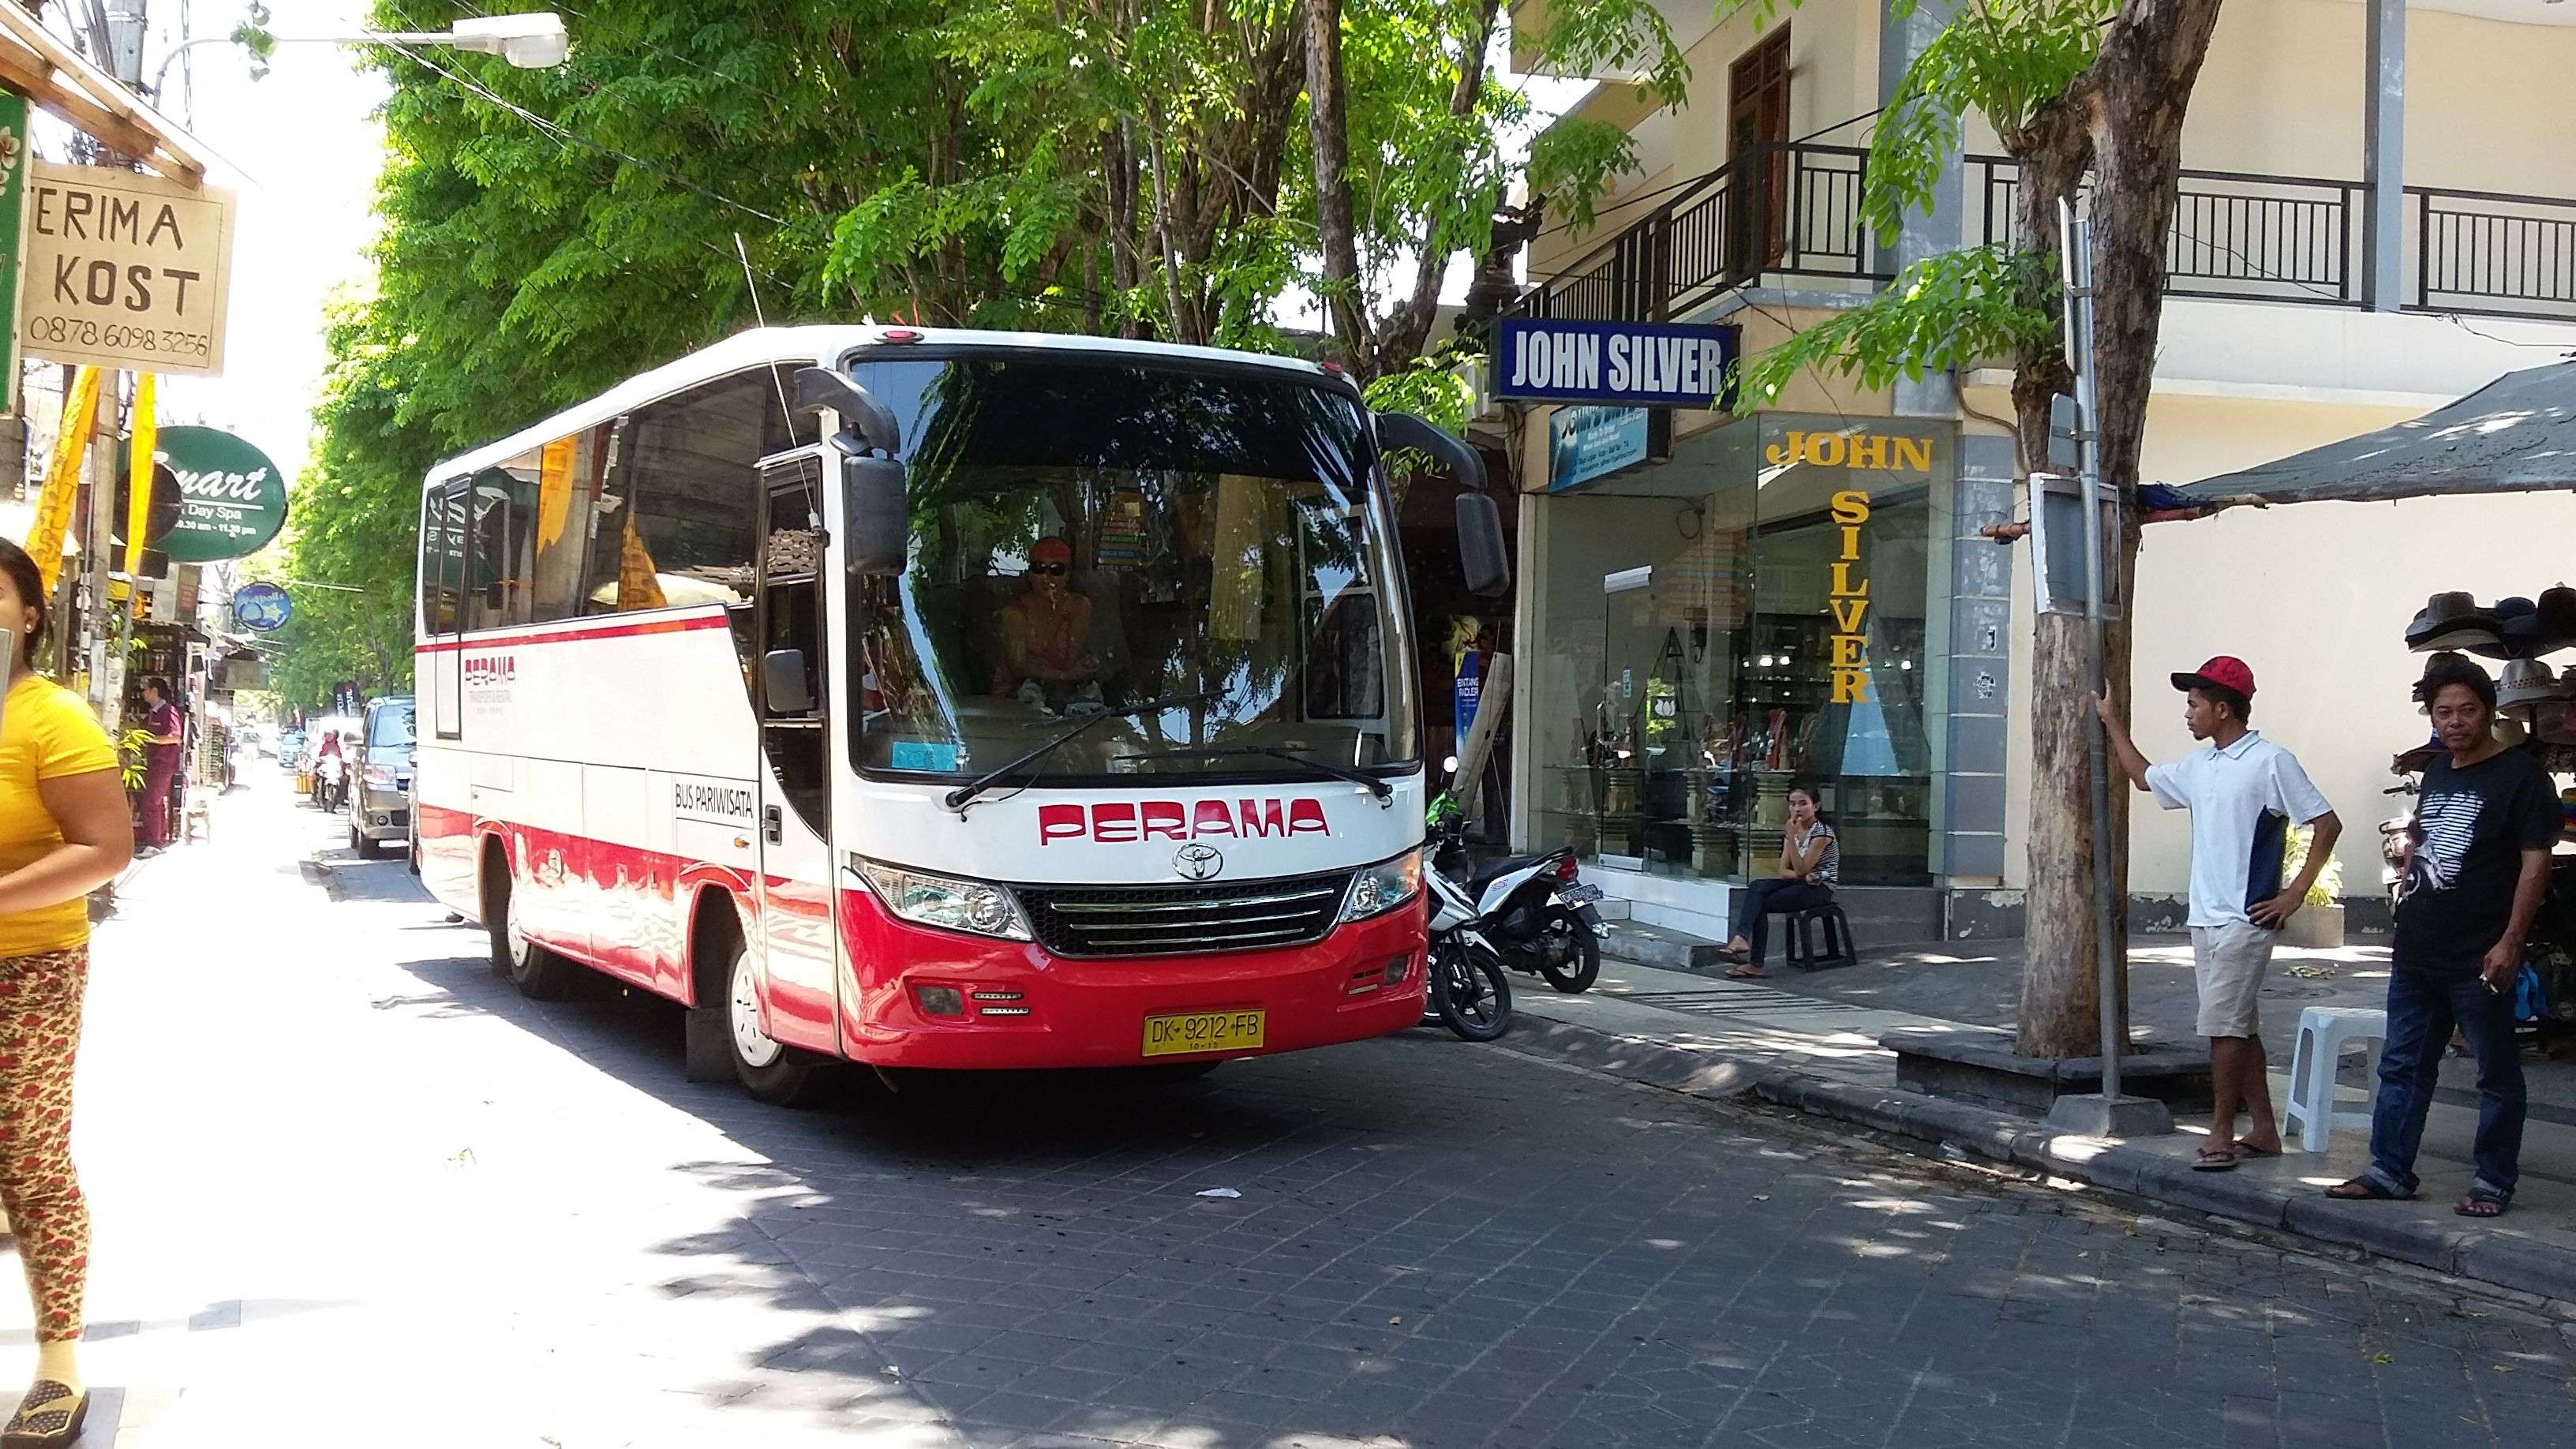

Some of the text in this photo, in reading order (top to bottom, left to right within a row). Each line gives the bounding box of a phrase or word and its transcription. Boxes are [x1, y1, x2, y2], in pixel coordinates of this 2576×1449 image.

[31, 187, 183, 251] ERIMA
[54, 254, 200, 316] KOST
[30, 316, 208, 356] 0878 6098 3256
[1512, 331, 1722, 395] JOHN SILVER
[1765, 432, 1934, 472] JOHN
[188, 504, 214, 520] Day
[215, 506, 243, 521] Spa
[1829, 491, 1870, 704] SILVER
[676, 783, 754, 819] BUS PARIWISATA
[1038, 799, 1331, 846] PERAMA
[1185, 1017, 1227, 1040] 9212
